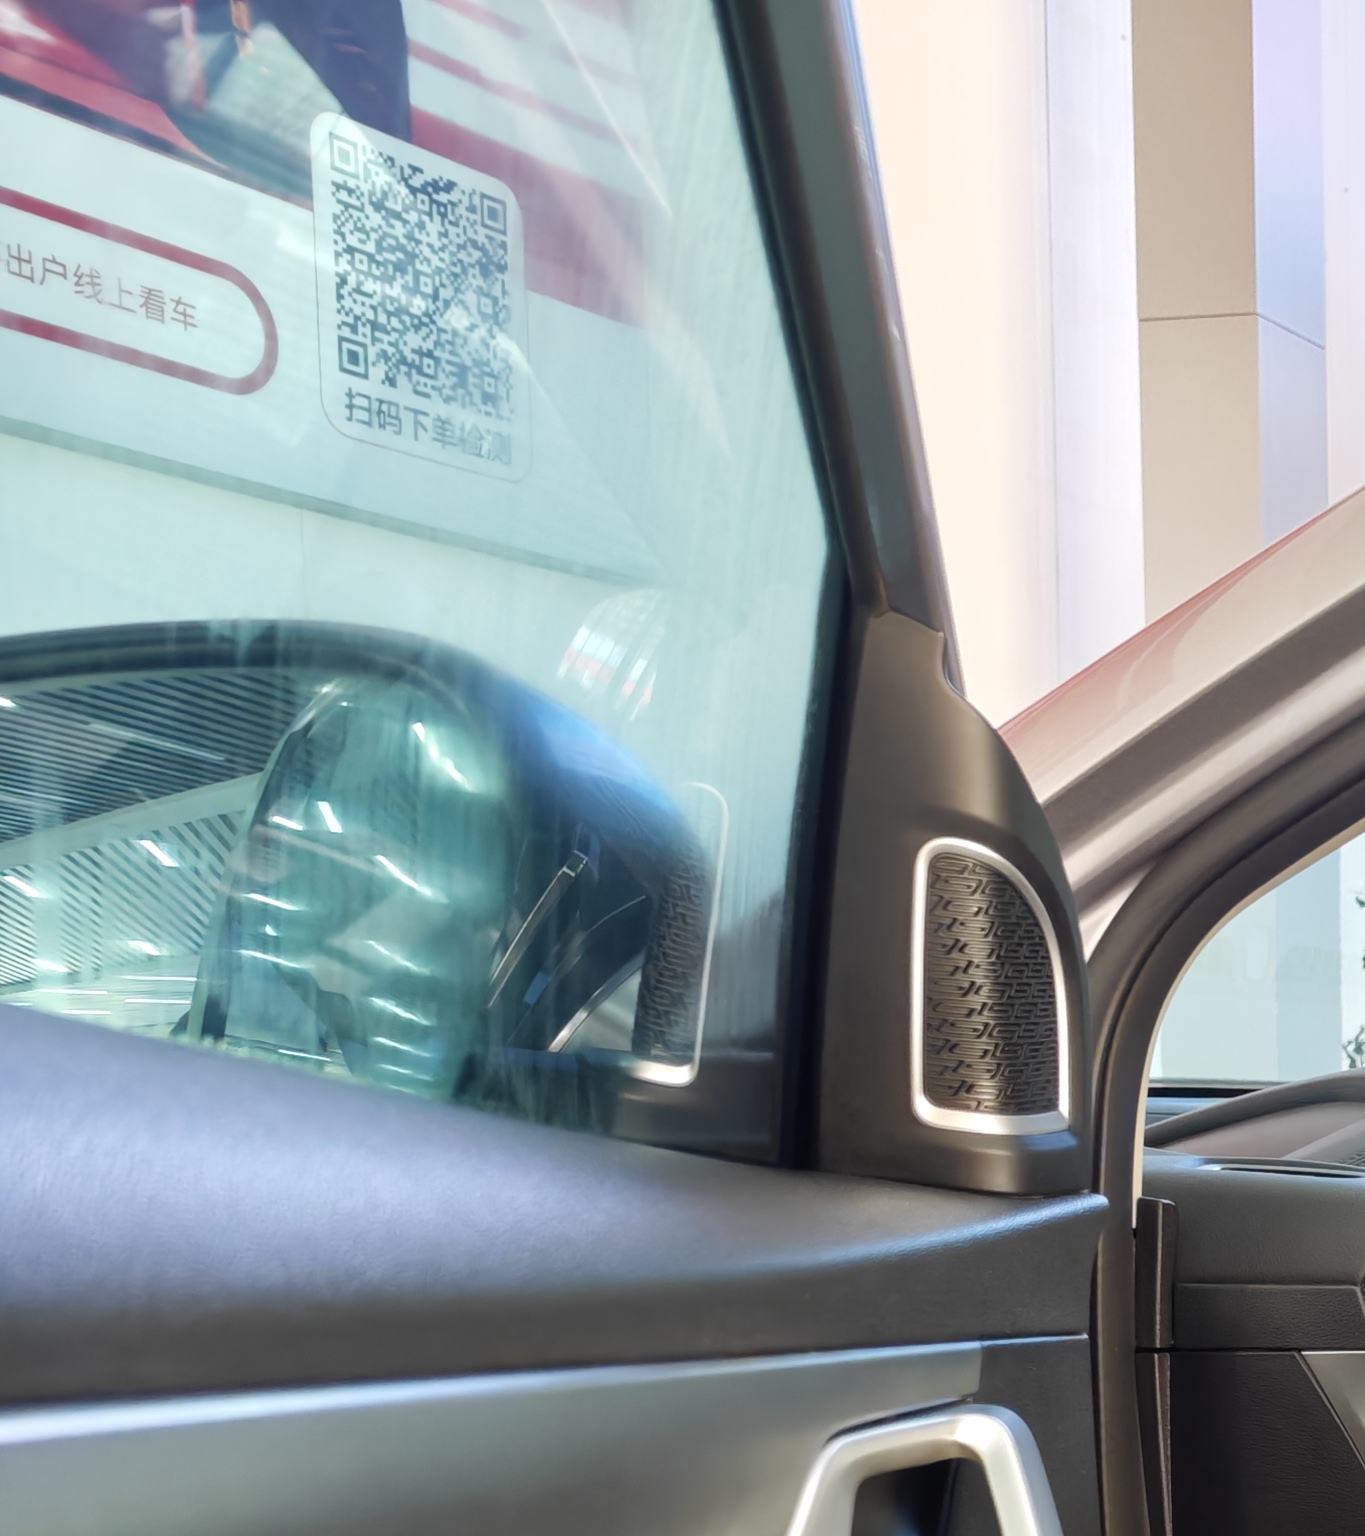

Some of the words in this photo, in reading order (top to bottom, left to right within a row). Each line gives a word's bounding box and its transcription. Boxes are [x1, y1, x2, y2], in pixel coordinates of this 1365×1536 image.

[0, 243, 198, 331] 出户线上看车
[344, 386, 512, 466] 扫码下单检测
